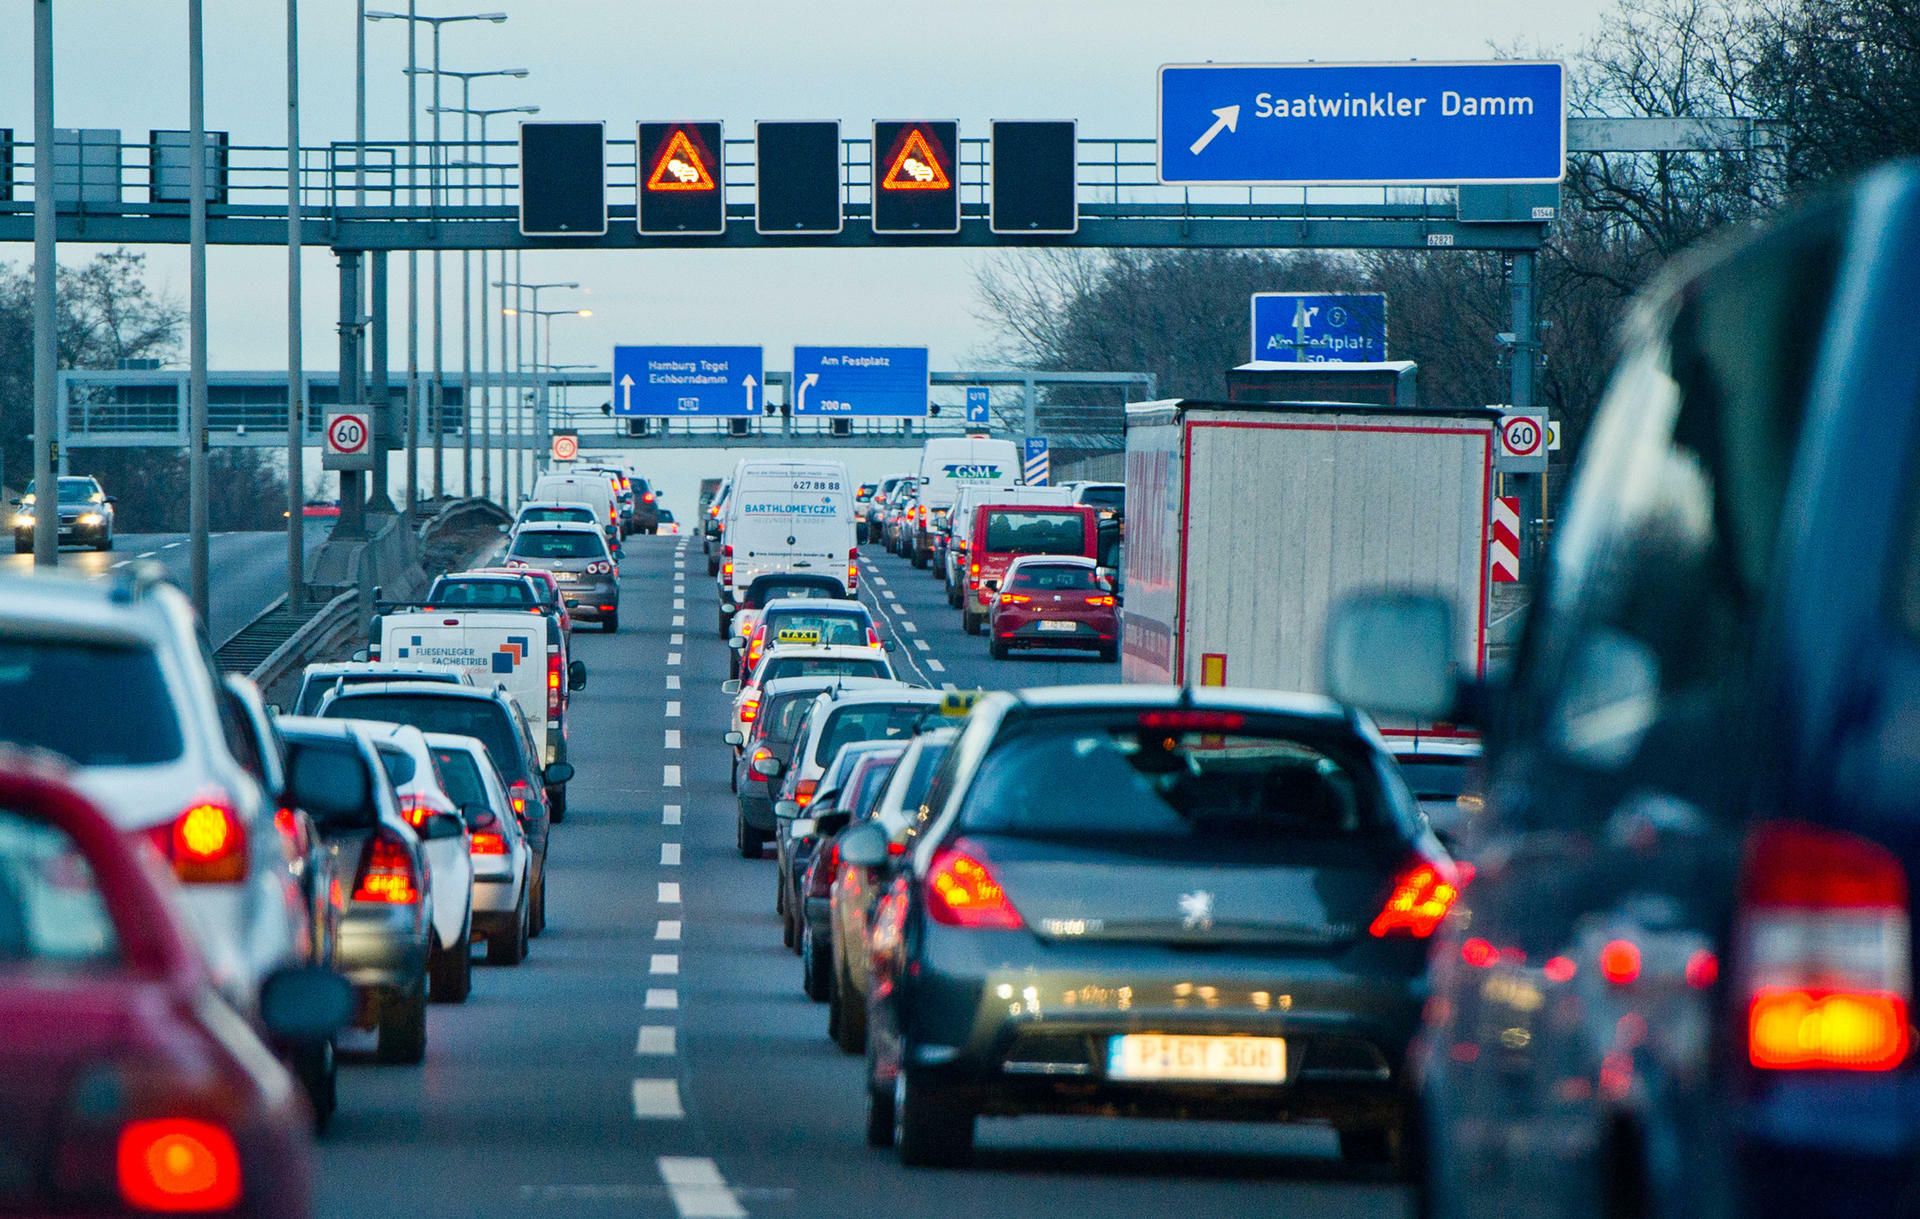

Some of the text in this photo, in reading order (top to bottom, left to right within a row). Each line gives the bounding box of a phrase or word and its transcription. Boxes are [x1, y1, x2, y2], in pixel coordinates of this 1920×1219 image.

[1254, 91, 1534, 118] Saatwinkler Damm
[1266, 335, 1294, 349] Am
[648, 360, 729, 373] Hamburg Tegel
[820, 355, 890, 368] Am Festplatz
[649, 373, 728, 384] Eichborndamm
[820, 400, 852, 411] 200 m
[337, 425, 359, 443] 60
[1511, 427, 1533, 445] 60
[955, 464, 991, 478] GSM
[793, 481, 811, 490] 627
[783, 631, 815, 639] TAXI
[415, 648, 475, 656] FLIESENLEGER
[432, 657, 488, 666] FACHBETRIEB
